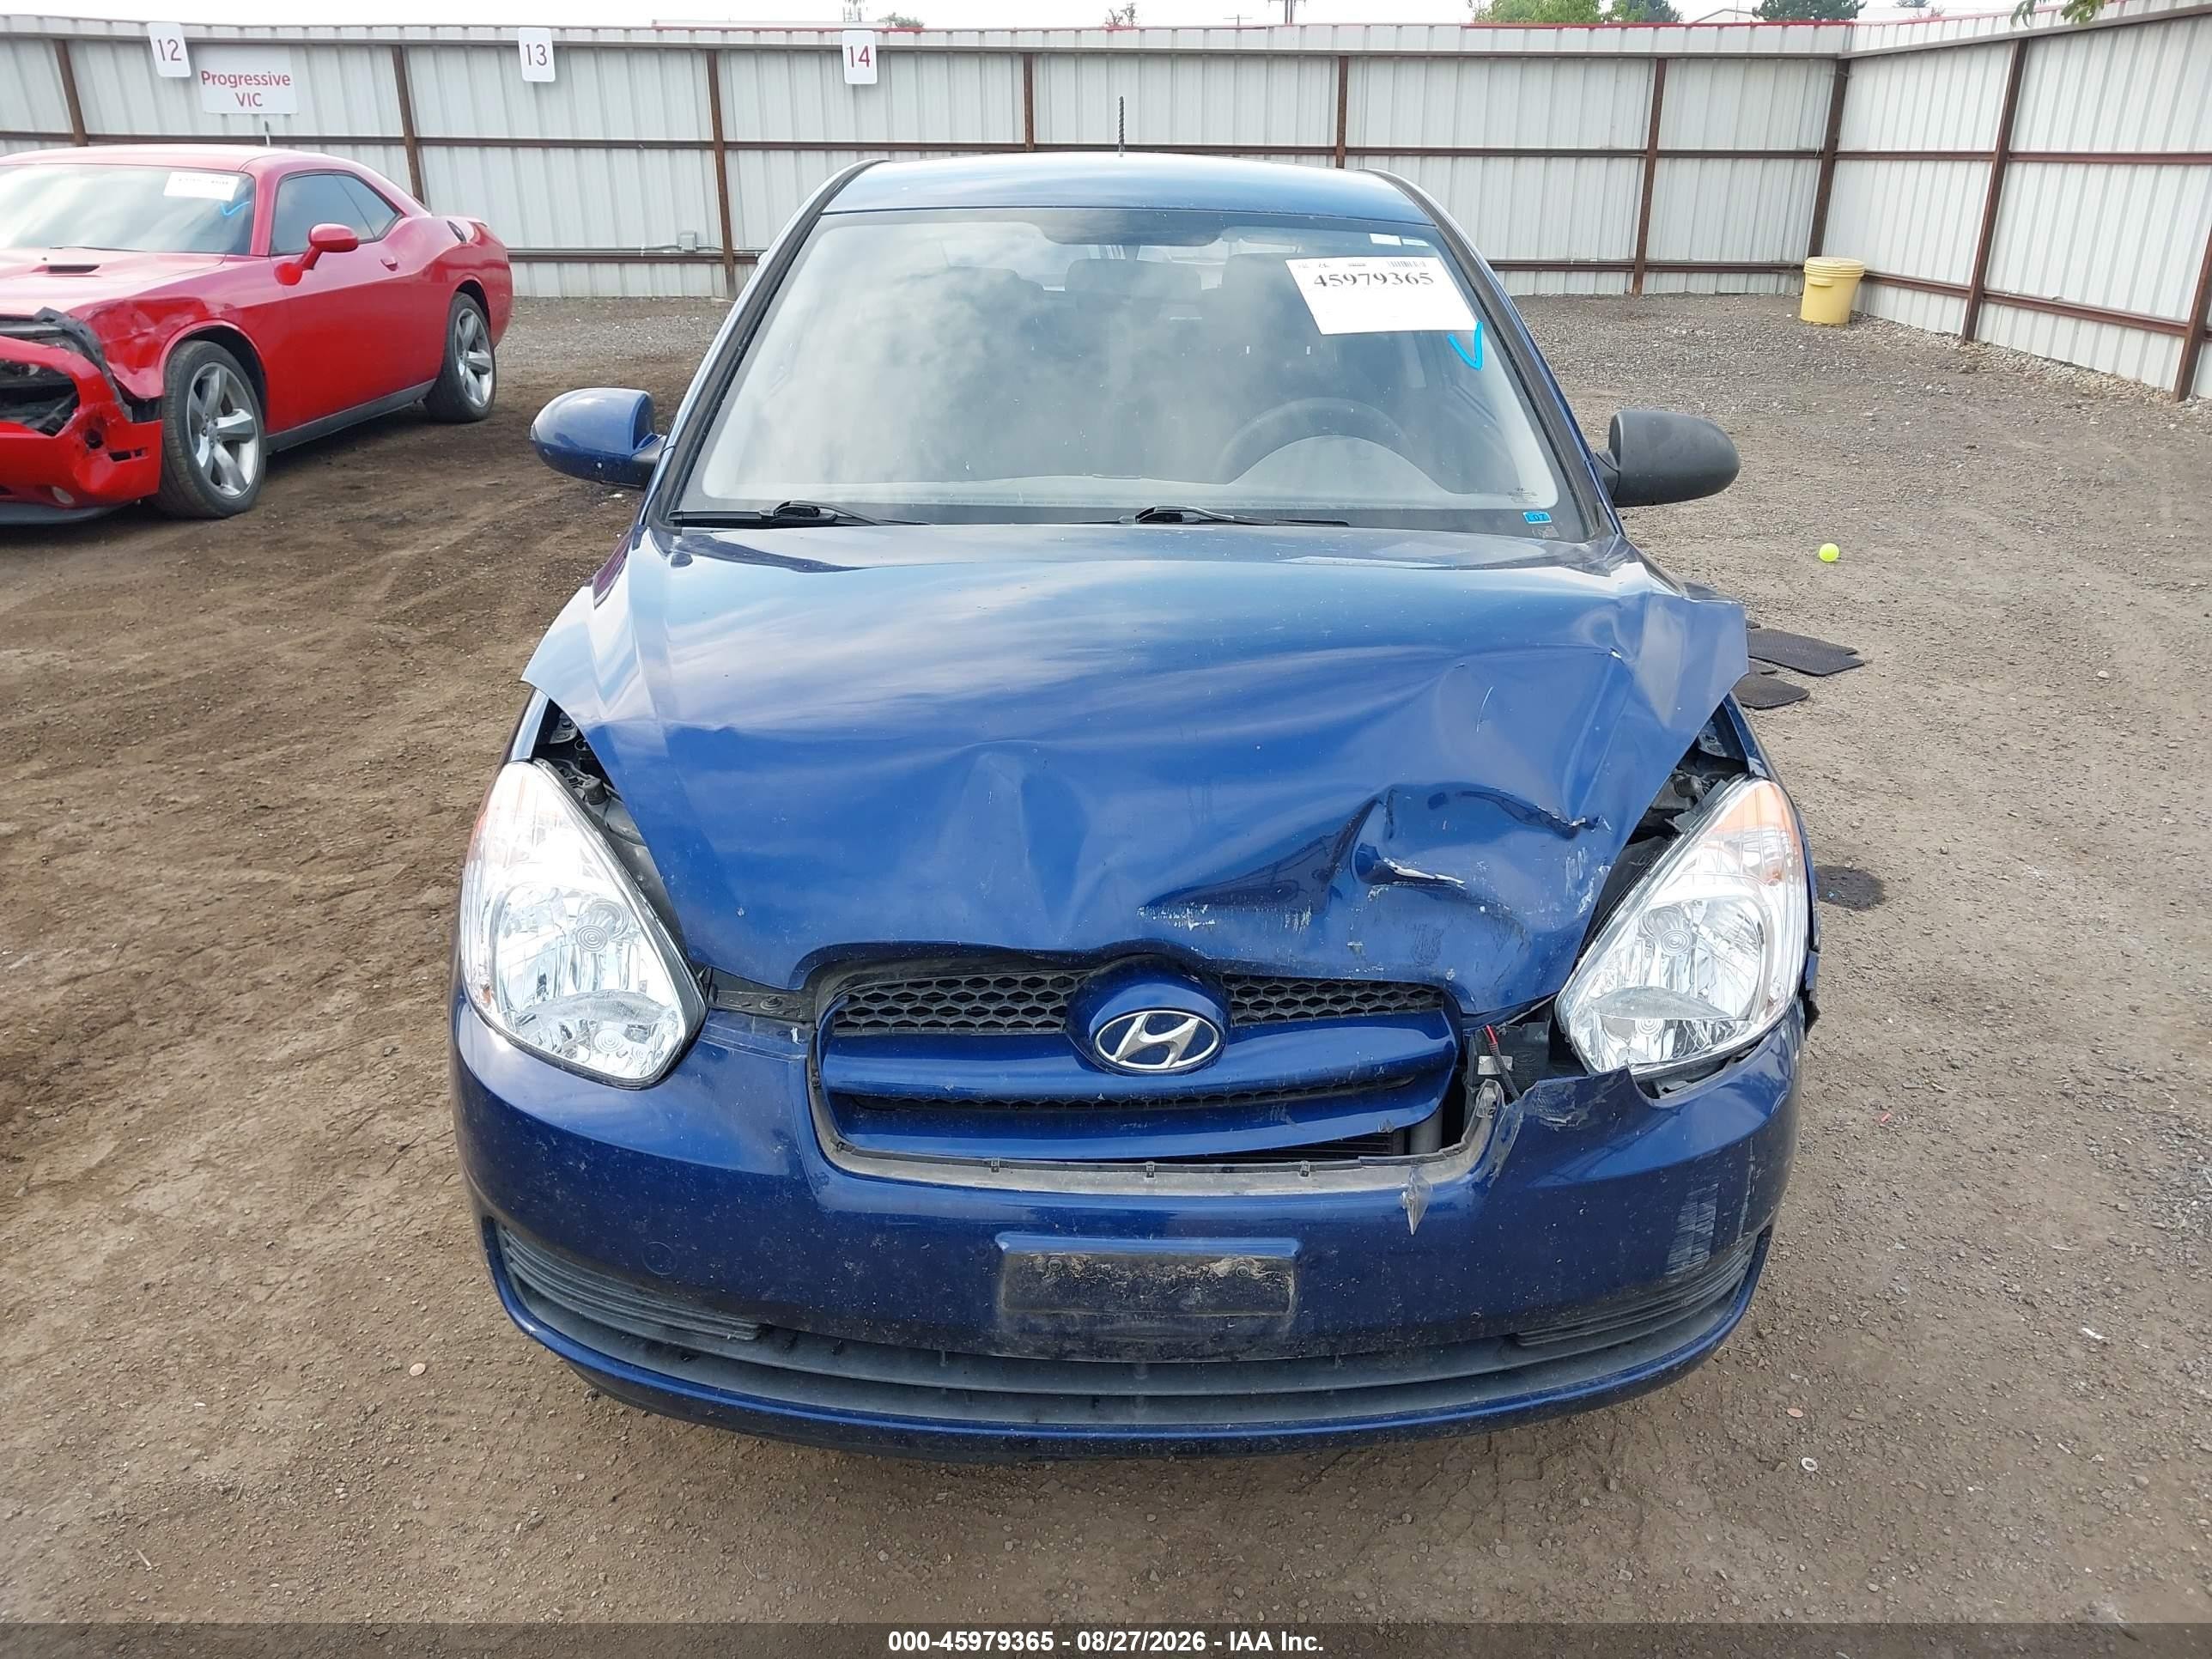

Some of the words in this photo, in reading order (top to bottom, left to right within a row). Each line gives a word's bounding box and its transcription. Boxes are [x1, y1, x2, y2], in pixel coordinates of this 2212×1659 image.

[158, 39, 182, 61] 12
[526, 44, 547, 66] 13
[848, 46, 870, 68] 14
[201, 70, 291, 88] Progressive
[235, 93, 264, 107] VIC
[1314, 272, 1434, 287] 45979365
